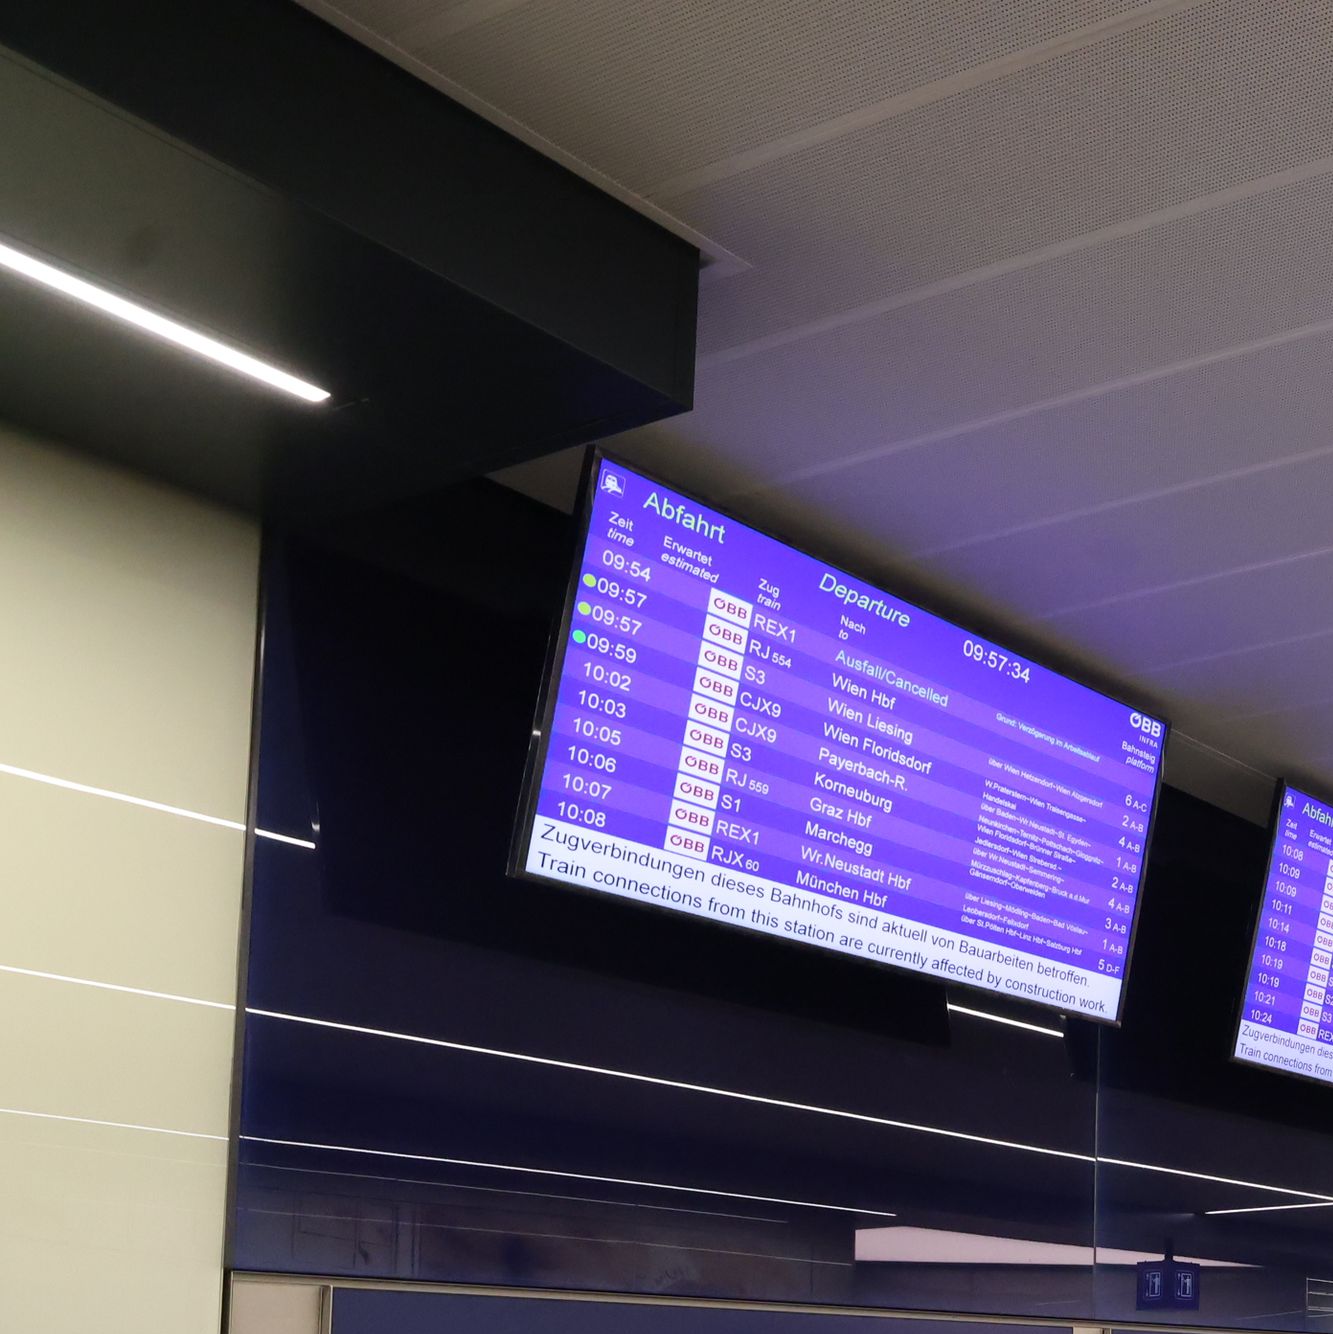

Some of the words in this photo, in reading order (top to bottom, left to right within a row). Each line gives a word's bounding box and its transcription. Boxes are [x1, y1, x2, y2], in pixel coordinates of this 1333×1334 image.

[602, 549, 650, 582] 09:54
[713, 597, 747, 619] ÖBB
[753, 613, 796, 643] REX1
[834, 649, 948, 707] Ausfall/Cancelled
[608, 511, 633, 532] Zeit
[663, 535, 712, 567] Erwartet
[758, 577, 780, 598] Zug
[840, 614, 866, 635] Nach
[642, 492, 725, 544] Abfahrt
[818, 572, 910, 627] Departure
[963, 639, 1030, 683] 09:57:34
[1129, 712, 1161, 737] ÖBB
[586, 633, 637, 663] 09:59
[739, 691, 781, 718] CJX9
[823, 721, 859, 747] Wien
[862, 737, 932, 774] Floridsdorf
[591, 605, 642, 635] 09:57
[744, 665, 765, 685] S3
[827, 697, 863, 723] Wien
[866, 713, 913, 745] Liesing
[596, 577, 647, 608] 09:57
[748, 638, 770, 659] RJ
[771, 651, 791, 668] 554
[832, 672, 867, 699] Wien
[870, 688, 896, 710] Hbf
[578, 689, 626, 718] 10:03
[729, 742, 751, 762] S3
[813, 771, 892, 813] Korneuburg
[583, 661, 631, 691] 10:02
[735, 717, 777, 743] CJX9
[818, 746, 907, 791] Payerbach-R.
[537, 850, 586, 879] Train
[592, 870, 702, 908] connections
[707, 896, 745, 920] from
[750, 908, 778, 928] this
[783, 919, 835, 943] station
[838, 935, 863, 950] are
[867, 942, 928, 969] currently
[930, 957, 984, 981] affected
[986, 970, 1002, 988] by
[1004, 978, 1076, 1005] construction
[1078, 997, 1109, 1013] work.
[540, 823, 705, 882] Zugverbindungen
[710, 872, 764, 898] dieses
[770, 887, 843, 920] Bahnhofs
[847, 912, 878, 929] sind
[881, 920, 927, 942] aktuell
[931, 935, 955, 950] von
[958, 939, 1033, 972] Bauarbeiten
[1036, 961, 1091, 987] betroffen.
[1279, 862, 1300, 879] 10:09
